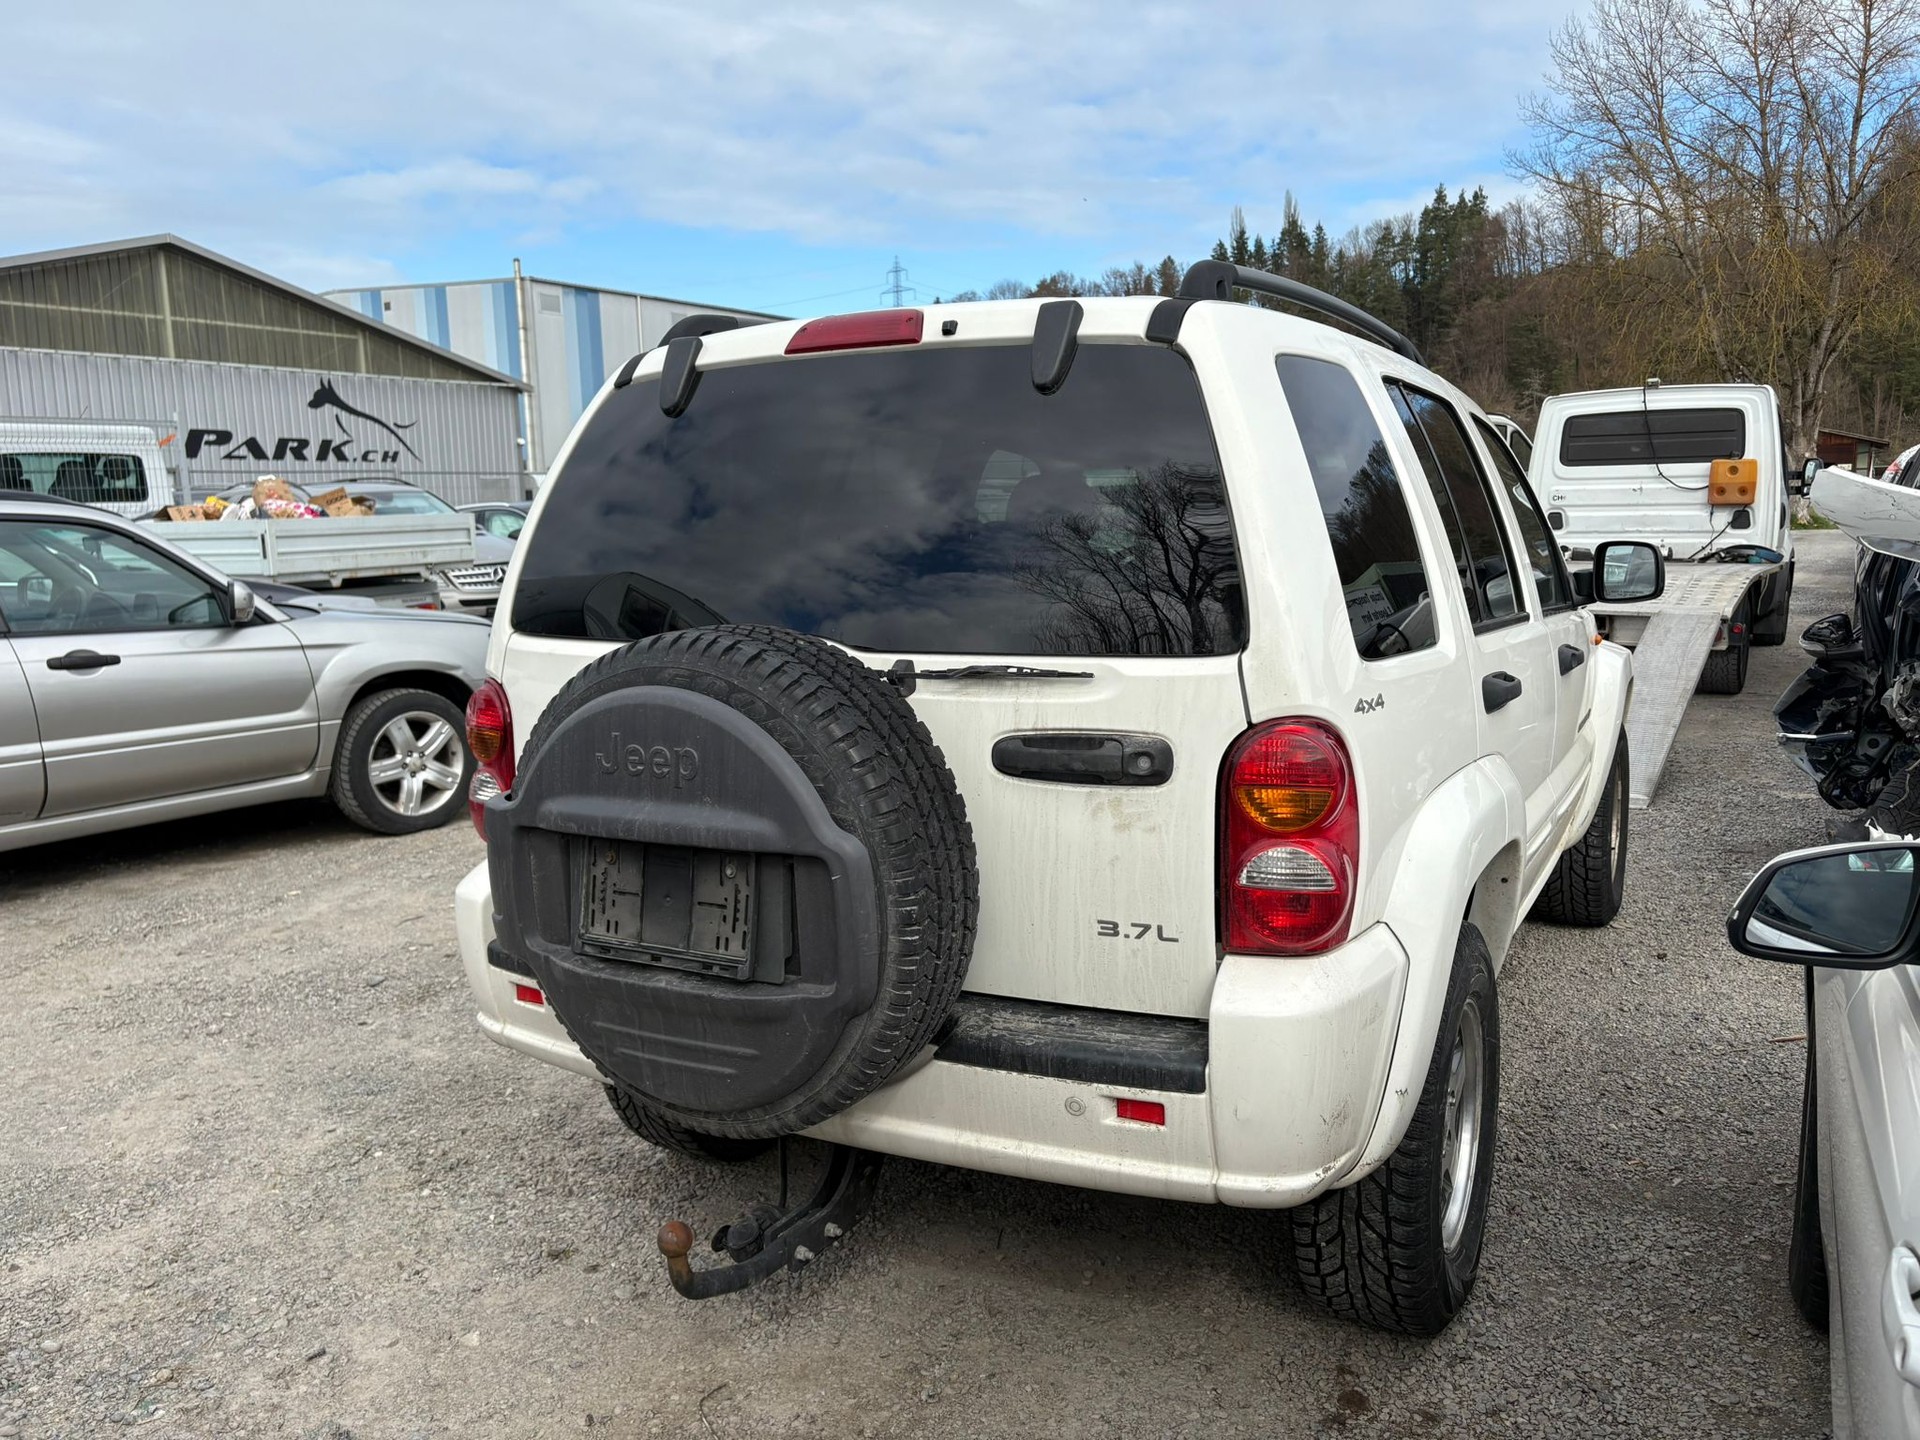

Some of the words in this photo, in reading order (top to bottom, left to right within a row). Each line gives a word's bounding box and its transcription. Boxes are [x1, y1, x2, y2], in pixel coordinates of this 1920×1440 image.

[184, 428, 400, 463] PARK.CH
[1354, 692, 1385, 714] 4x4
[595, 731, 699, 790] Jeep
[1097, 919, 1179, 943] 3.7L
